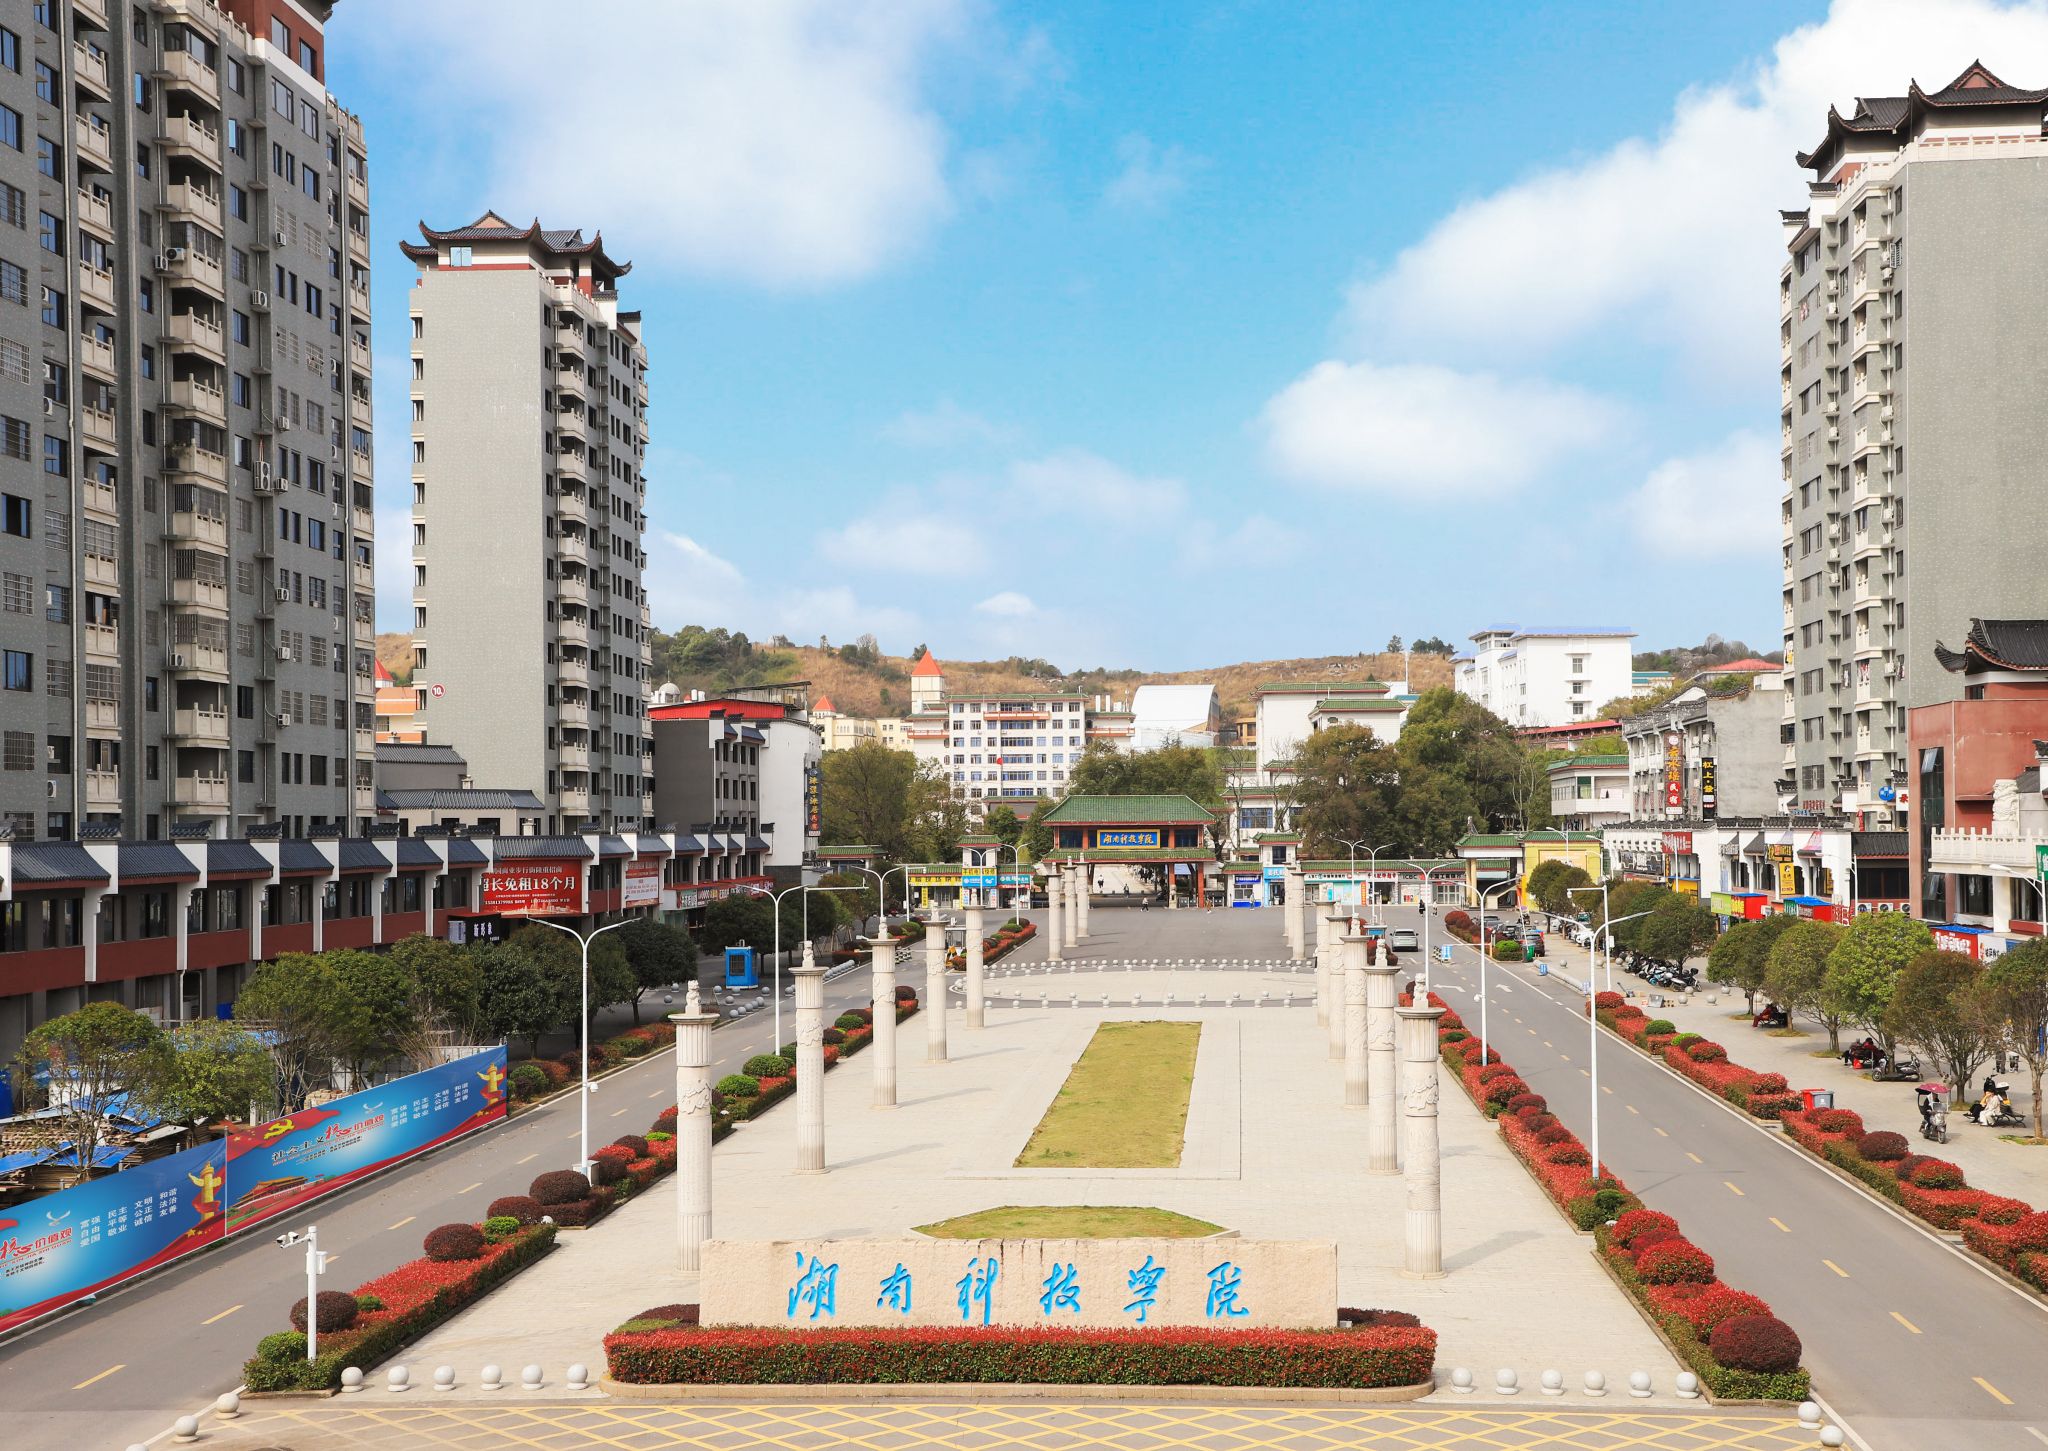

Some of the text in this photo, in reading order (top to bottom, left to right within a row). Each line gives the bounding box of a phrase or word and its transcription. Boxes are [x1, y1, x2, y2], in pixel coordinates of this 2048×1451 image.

[1103, 833, 1154, 845] 湖南科技学院
[434, 1088, 450, 1098] 文明
[454, 1082, 469, 1092] 和谐
[271, 1113, 385, 1162] 社会主义核心价值观
[79, 1205, 177, 1248] 爱国 敬业 诚信 友善
[80, 1187, 178, 1230] 富强 民主 文明 和谐
[80, 1197, 177, 1238] 自由 平等 公正 法治
[786, 1252, 1252, 1327] 湖南科技学院
